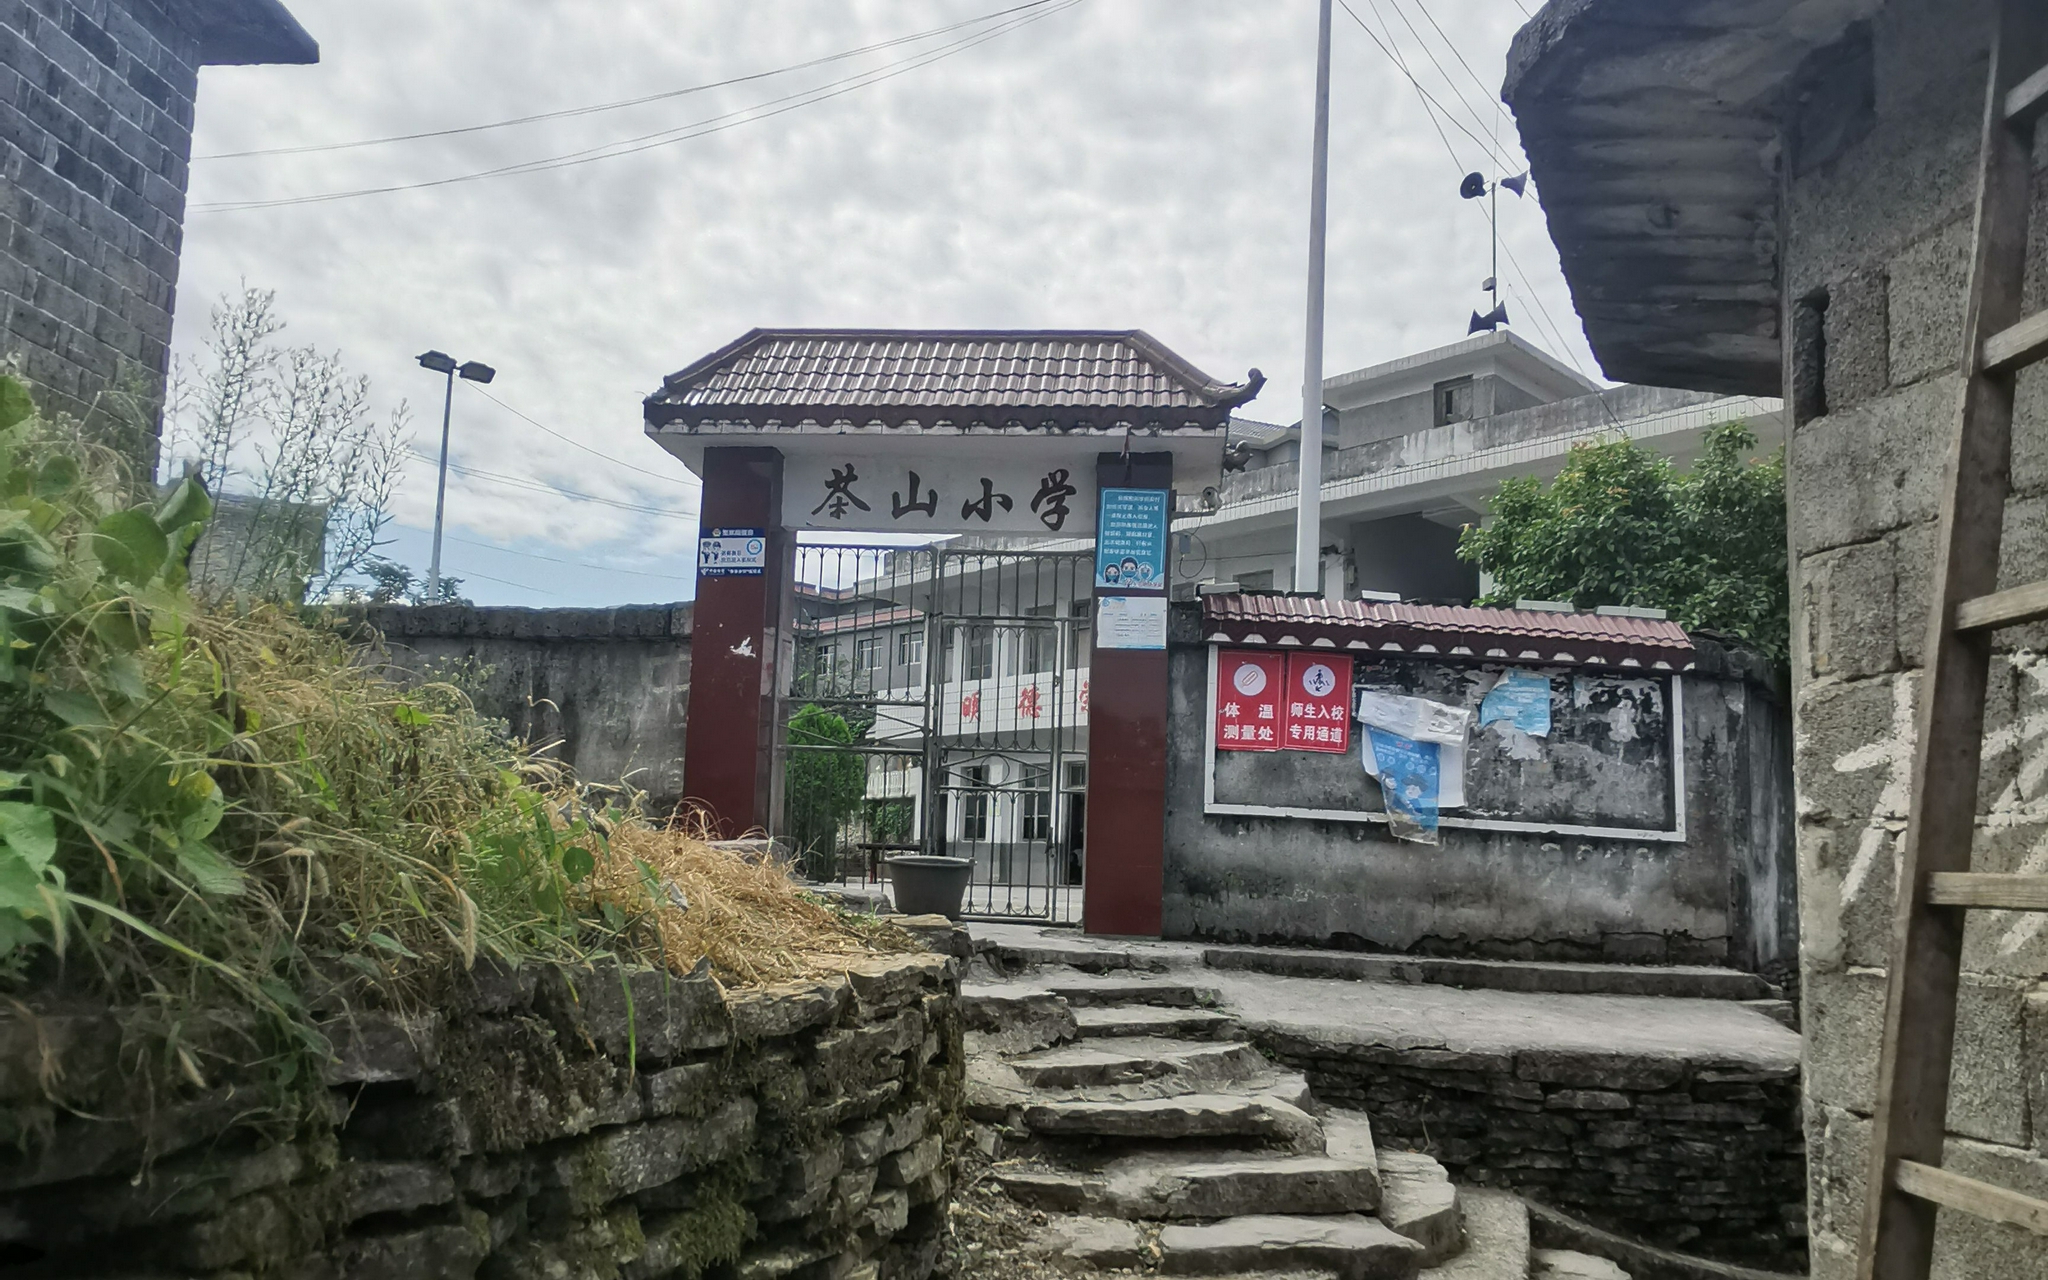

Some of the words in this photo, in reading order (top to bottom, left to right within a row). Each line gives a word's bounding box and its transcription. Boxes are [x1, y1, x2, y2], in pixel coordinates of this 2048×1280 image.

[811, 463, 1077, 531] 茶山小学
[1224, 702, 1274, 719] 体温
[1291, 702, 1345, 721] 师生入校
[1223, 724, 1274, 741] 测量处
[1289, 723, 1343, 743] 专用通道
